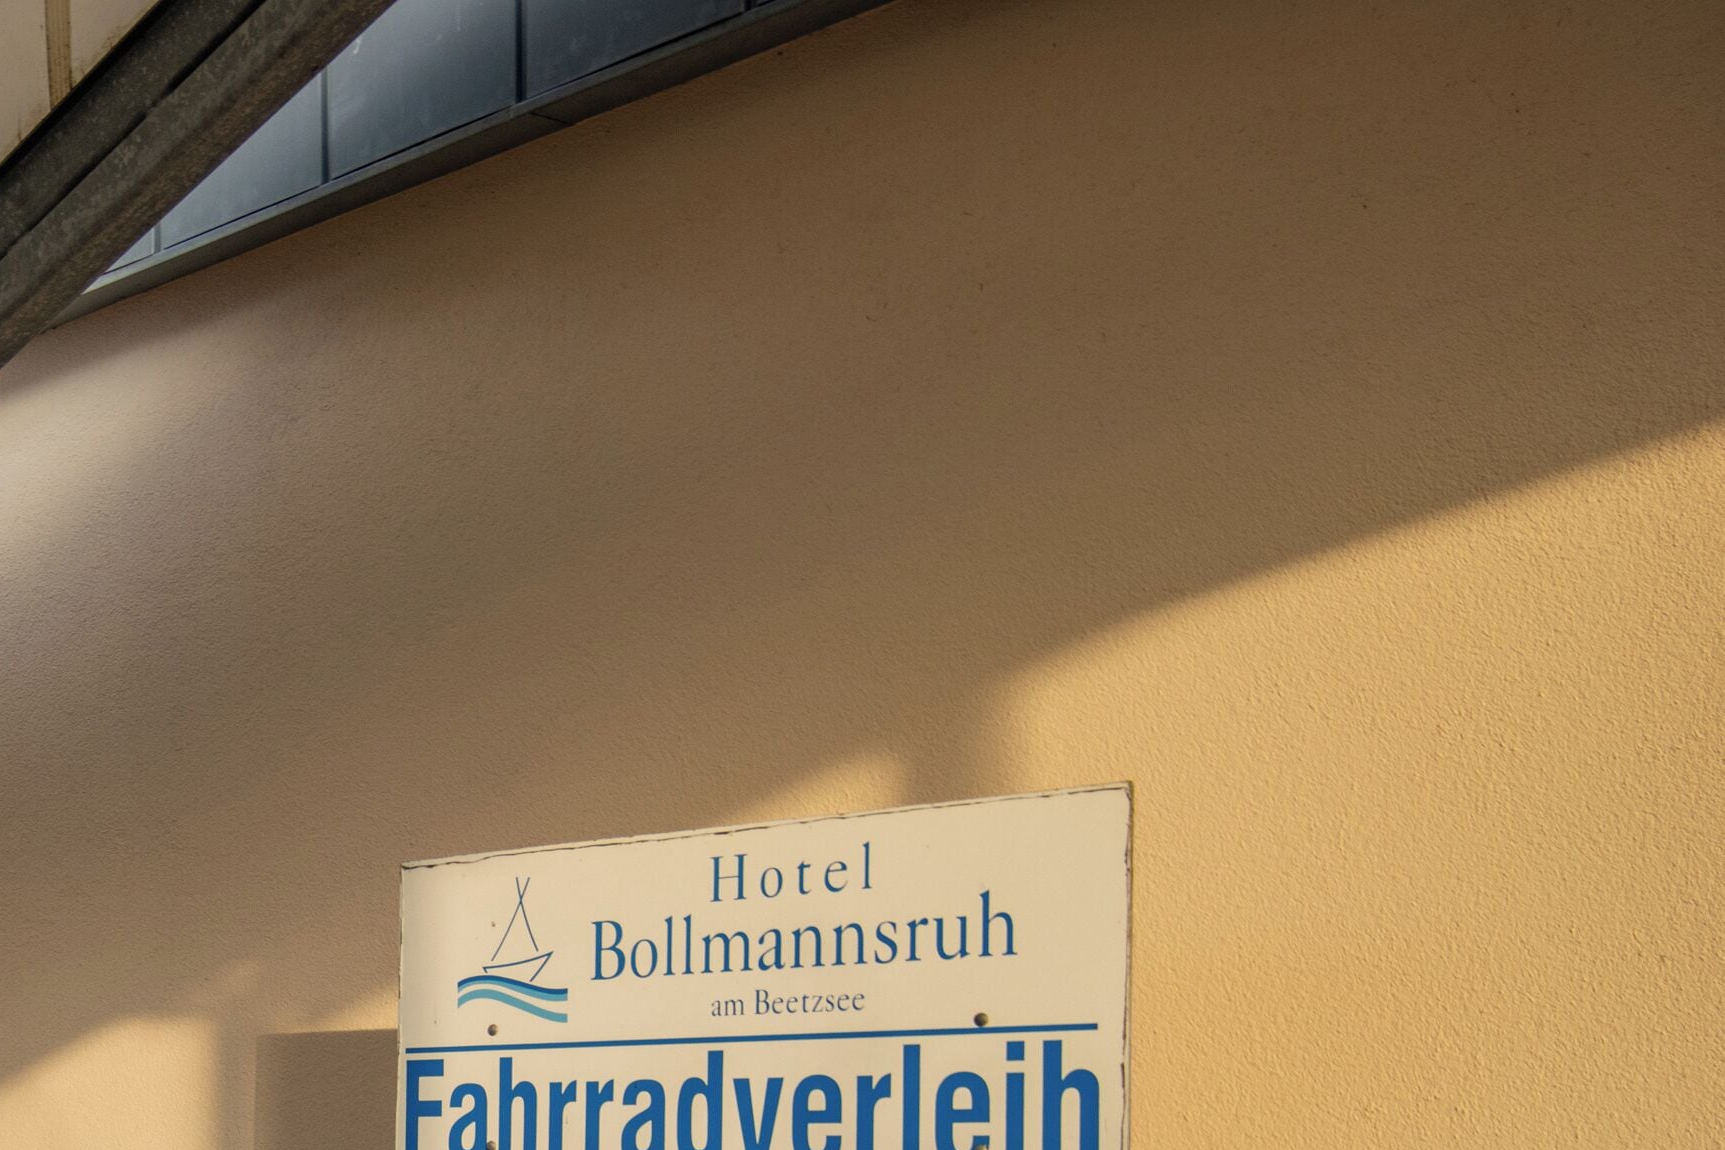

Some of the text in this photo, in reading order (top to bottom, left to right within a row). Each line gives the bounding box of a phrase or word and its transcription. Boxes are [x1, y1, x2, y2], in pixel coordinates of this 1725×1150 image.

[709, 842, 874, 902] Hotel
[591, 889, 1018, 981] Bollmannsruh
[711, 988, 866, 1018] am Beetzsee
